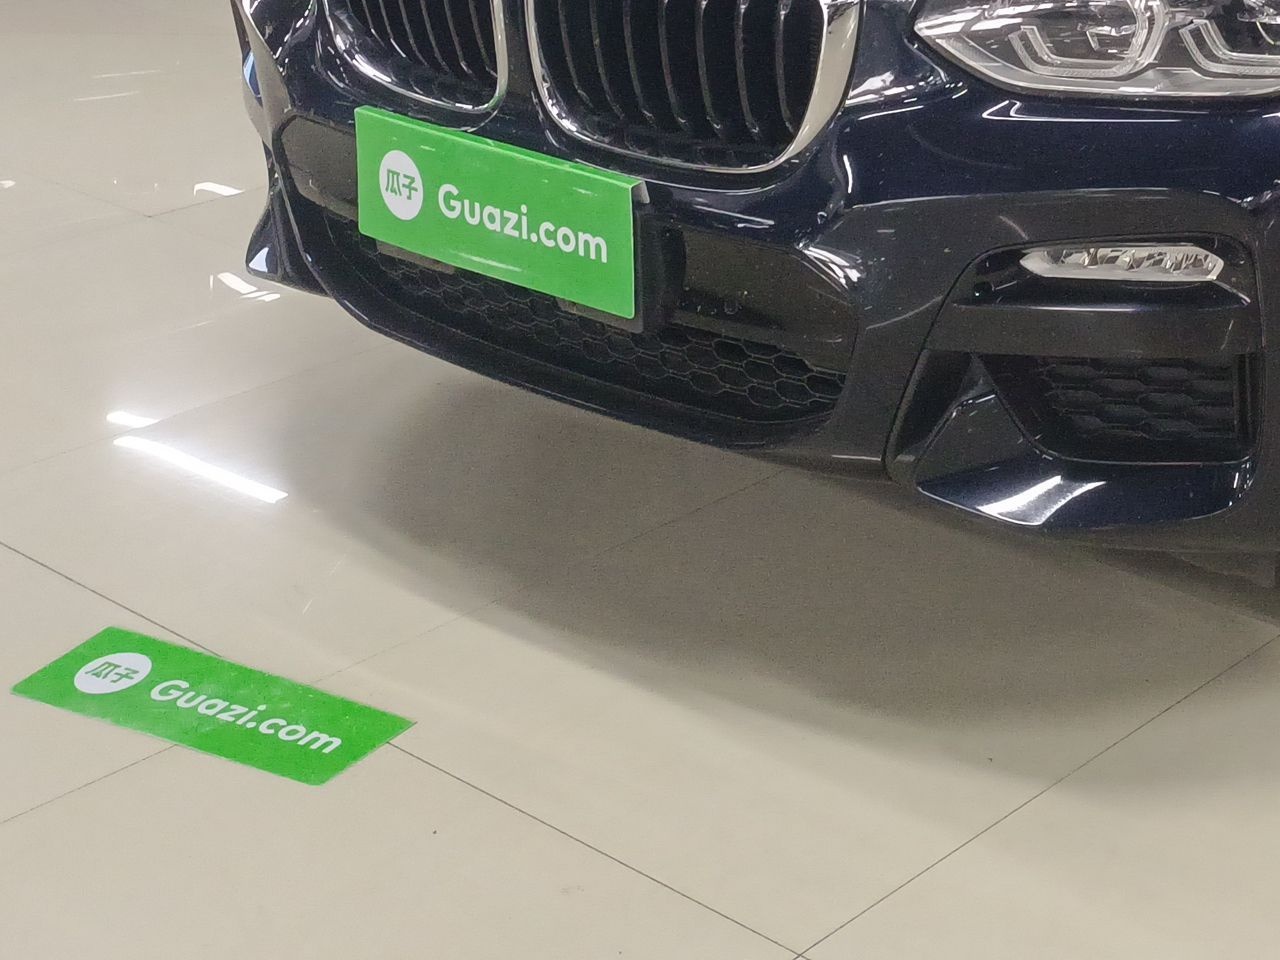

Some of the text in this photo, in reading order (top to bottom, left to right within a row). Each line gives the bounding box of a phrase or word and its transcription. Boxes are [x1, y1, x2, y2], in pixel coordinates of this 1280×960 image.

[385, 168, 608, 263] 瓜子 Guazi.com
[85, 661, 342, 753] 瓜子 Guazi.com
